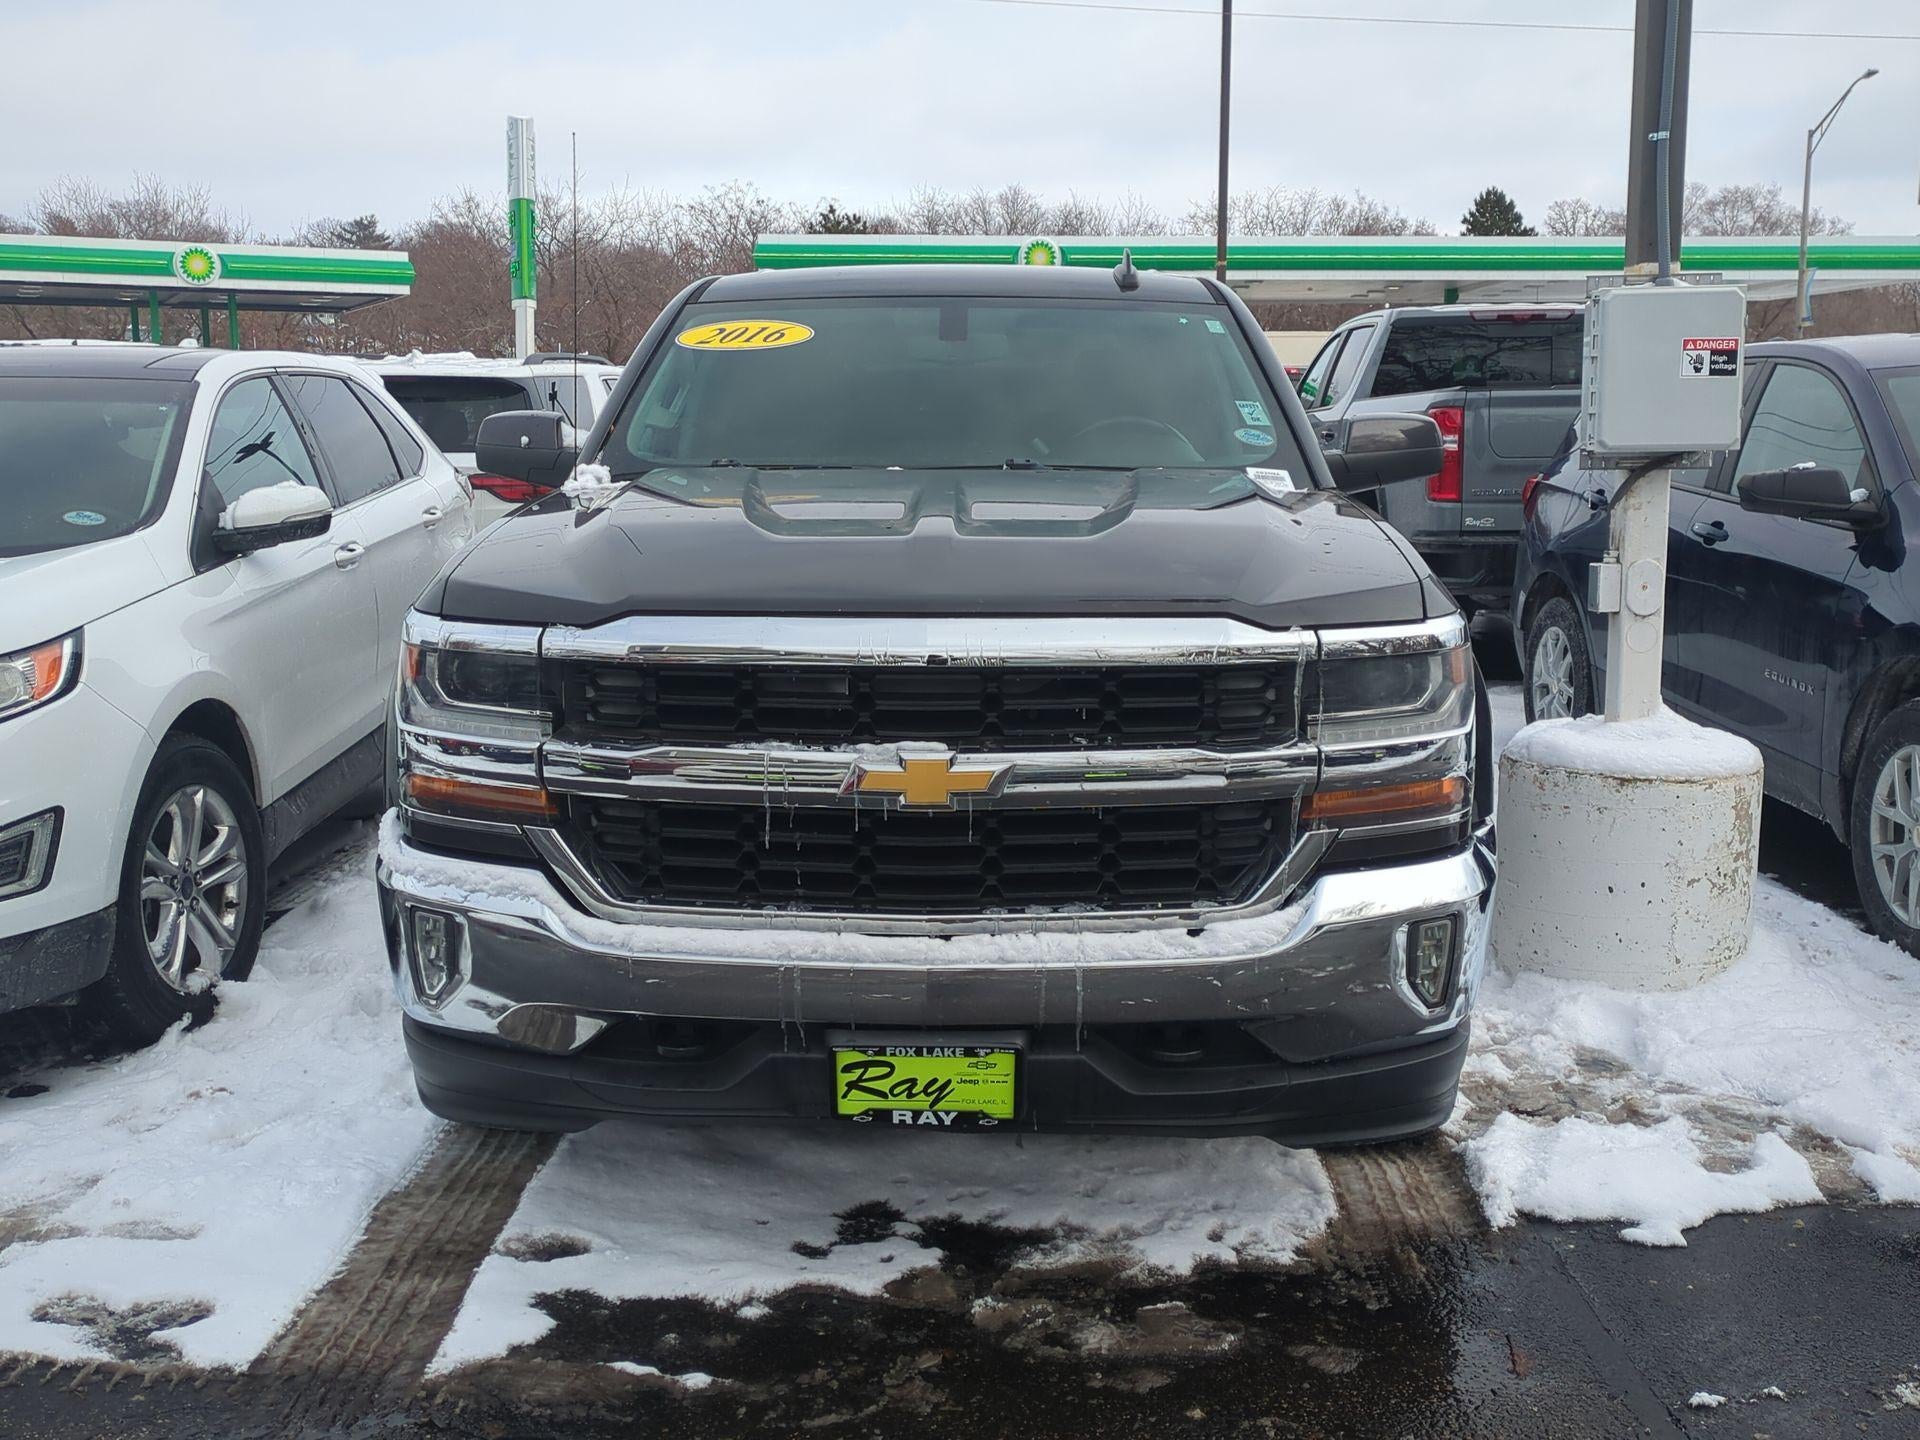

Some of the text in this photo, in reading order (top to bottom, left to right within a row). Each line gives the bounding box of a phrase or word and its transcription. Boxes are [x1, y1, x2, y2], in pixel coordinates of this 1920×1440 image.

[693, 326, 796, 345] 2016
[1696, 340, 1736, 349] DANGER
[1710, 363, 1737, 371] voltage
[1764, 668, 1815, 696] EQUINOX
[886, 1047, 917, 1058] FOX
[922, 1047, 965, 1058] LAKE
[840, 1059, 956, 1109] Ray
[956, 1077, 980, 1086] Jeep
[961, 1097, 976, 1105] FOX
[892, 1110, 958, 1126] RAY
